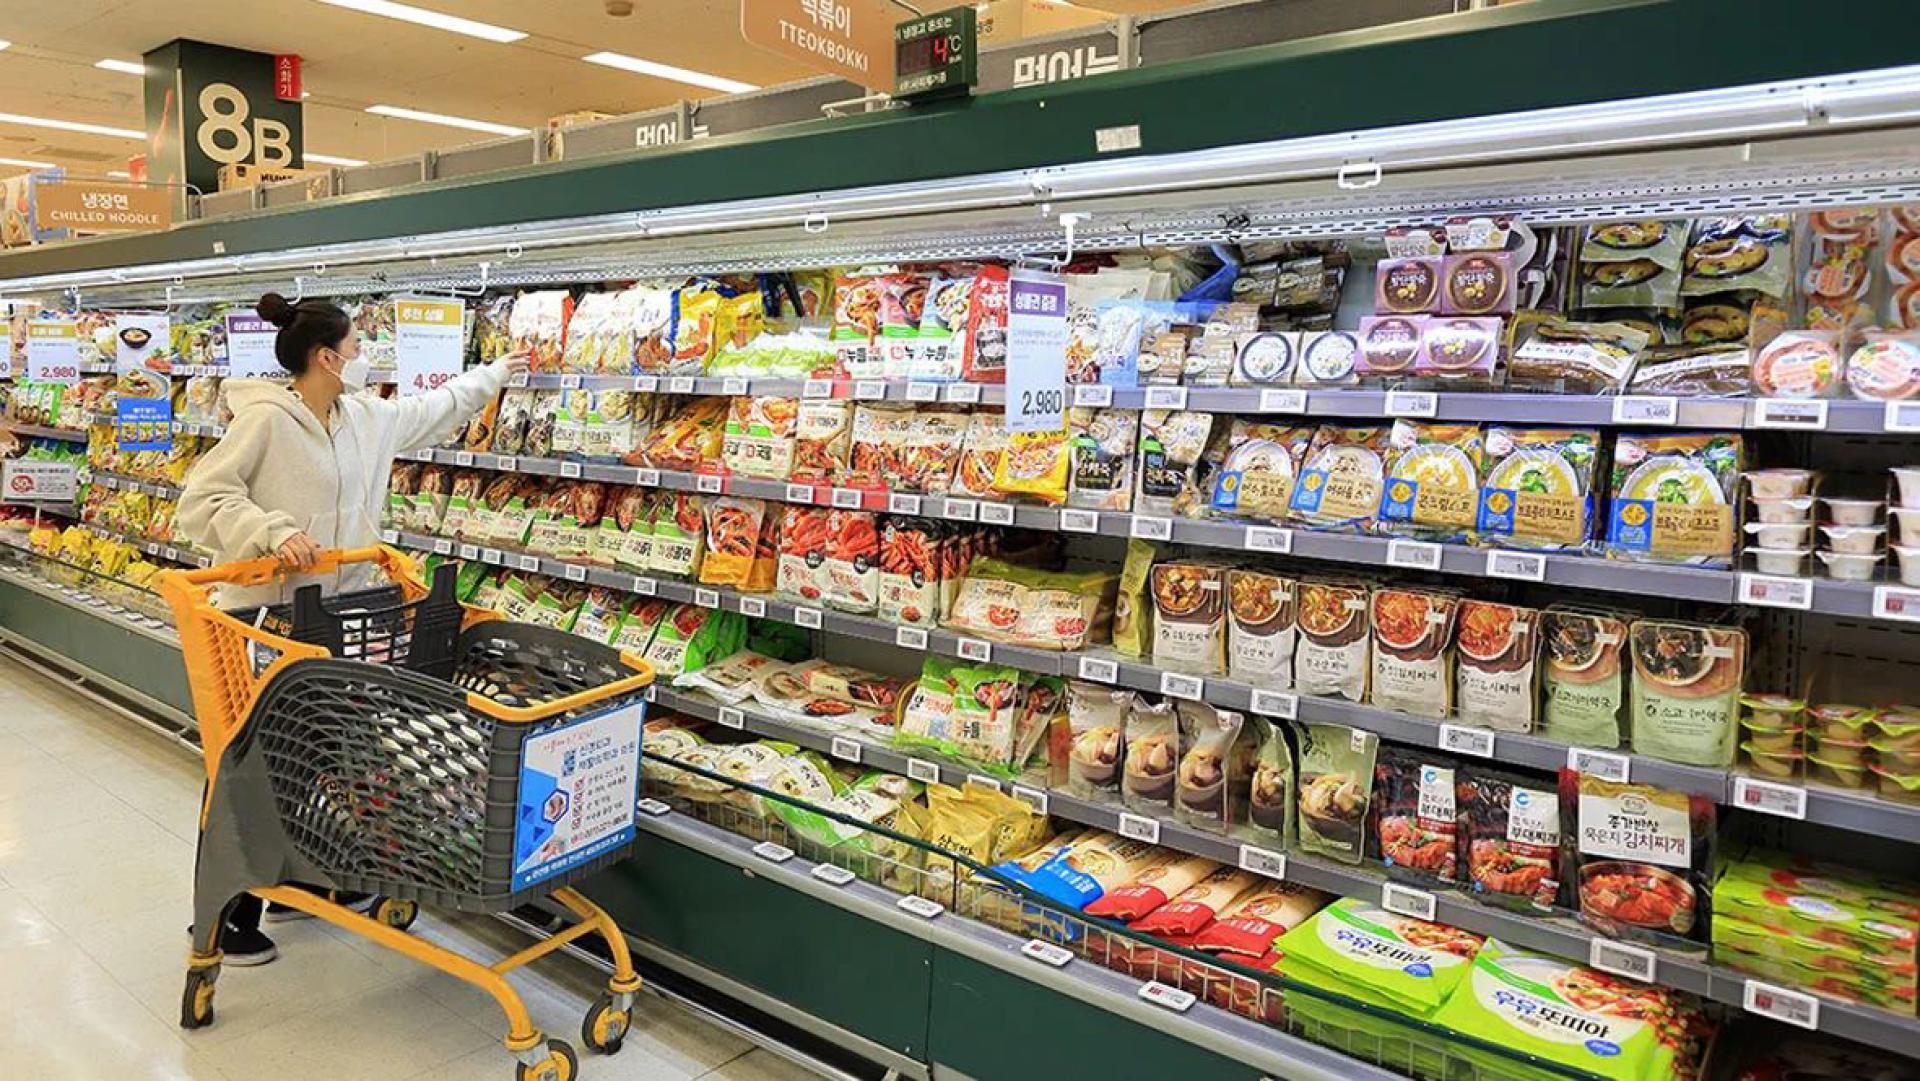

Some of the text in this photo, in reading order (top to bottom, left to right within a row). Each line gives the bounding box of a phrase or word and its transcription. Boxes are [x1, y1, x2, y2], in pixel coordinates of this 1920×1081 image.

[779, 20, 868, 72] TTEOKBOKKI
[280, 57, 292, 97] 소화기
[197, 83, 292, 168] 8B
[51, 211, 159, 225] CHILLED NOODLE
[1022, 390, 1062, 417] 2,980
[1623, 831, 1685, 856] 김치찌개
